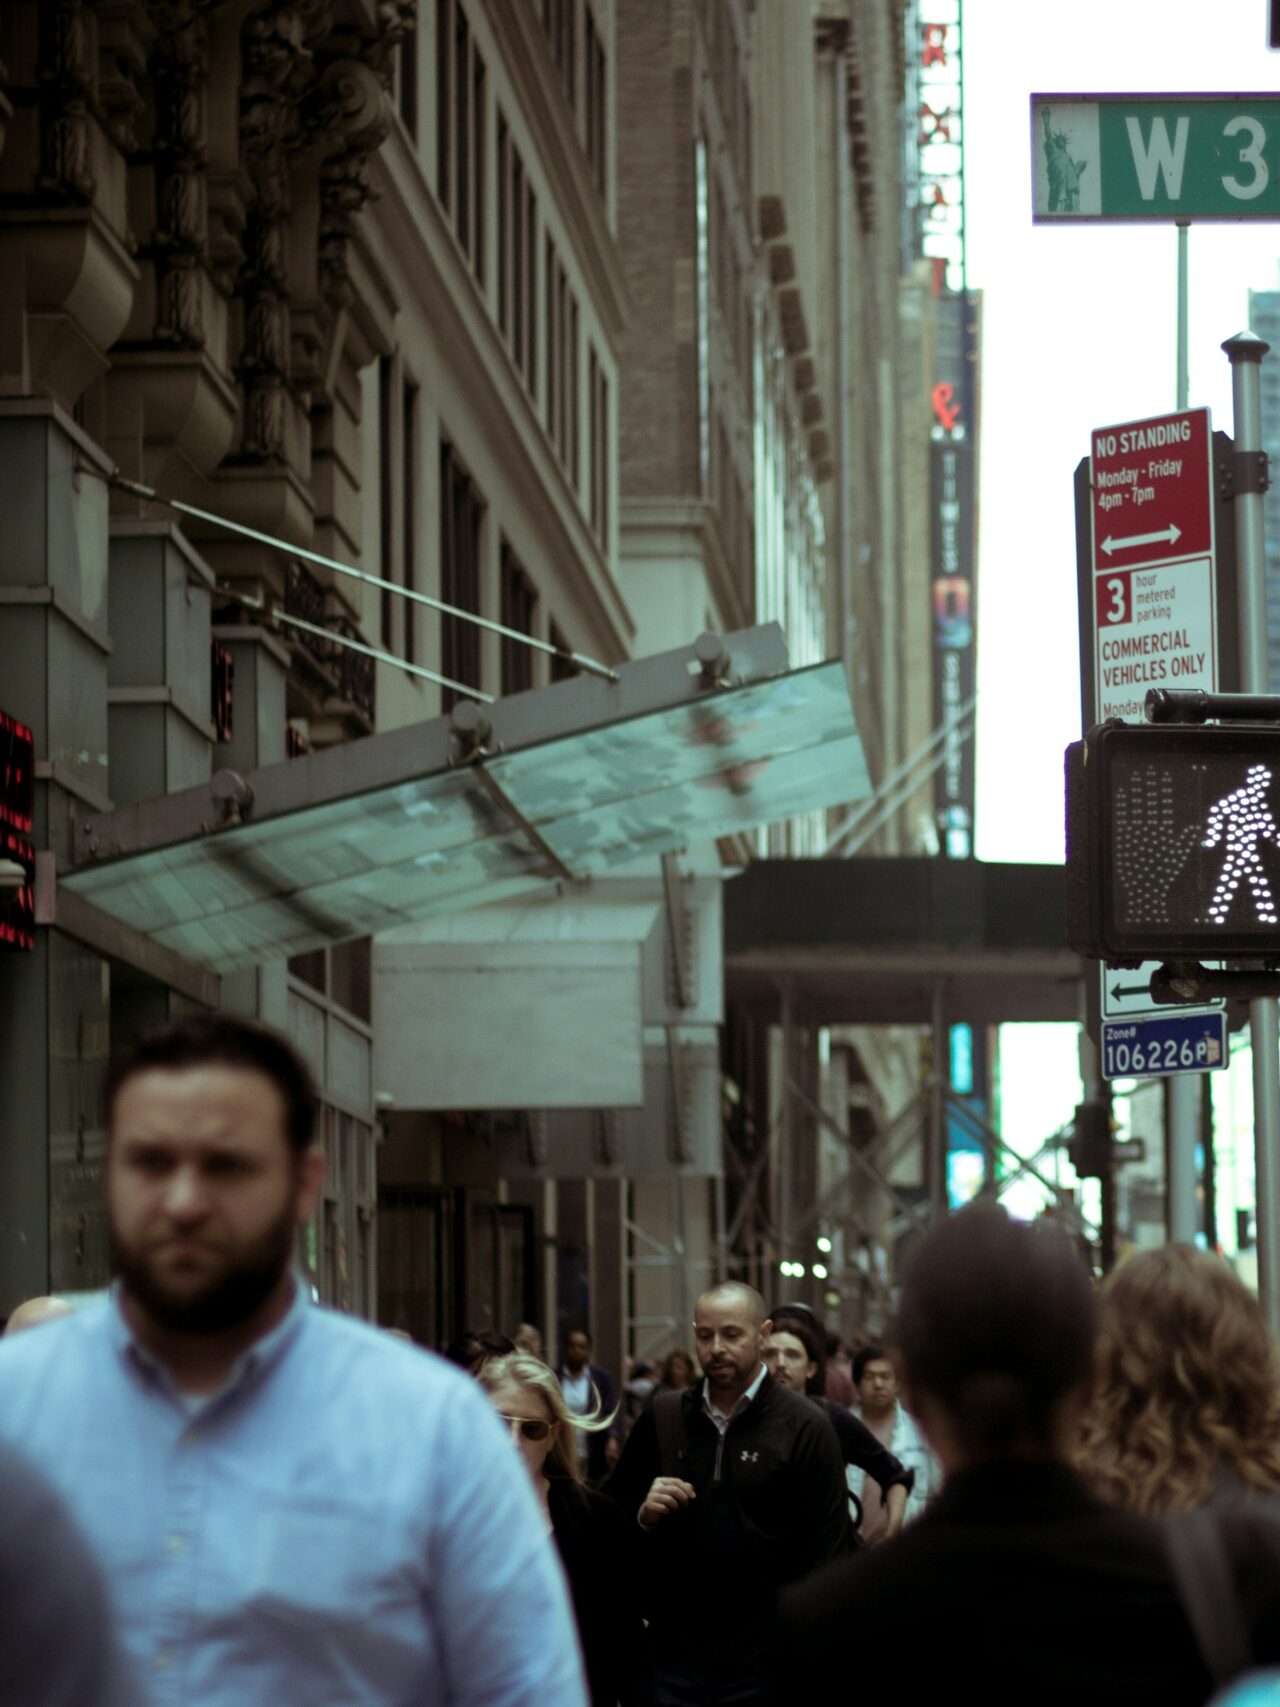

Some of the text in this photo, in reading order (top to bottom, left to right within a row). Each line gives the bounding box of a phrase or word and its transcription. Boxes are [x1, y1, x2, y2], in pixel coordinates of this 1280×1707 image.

[1125, 116, 1190, 201] W
[1096, 419, 1191, 458] NO STANDING
[1097, 467, 1138, 489] Monday
[1148, 459, 1182, 479] Friday
[1098, 493, 1122, 512] 4pm
[1131, 486, 1155, 506] 7pm
[1136, 574, 1157, 588] hour
[1136, 585, 1176, 605] metered
[1106, 578, 1126, 623] 3
[1137, 605, 1172, 624] parking
[1102, 628, 1191, 662] COMMERCIAL
[1103, 652, 1206, 688] VEHICLES ONLY
[1103, 699, 1144, 718] Monday
[1106, 1025, 1137, 1041] Zone#
[1107, 1038, 1194, 1073] 106226
